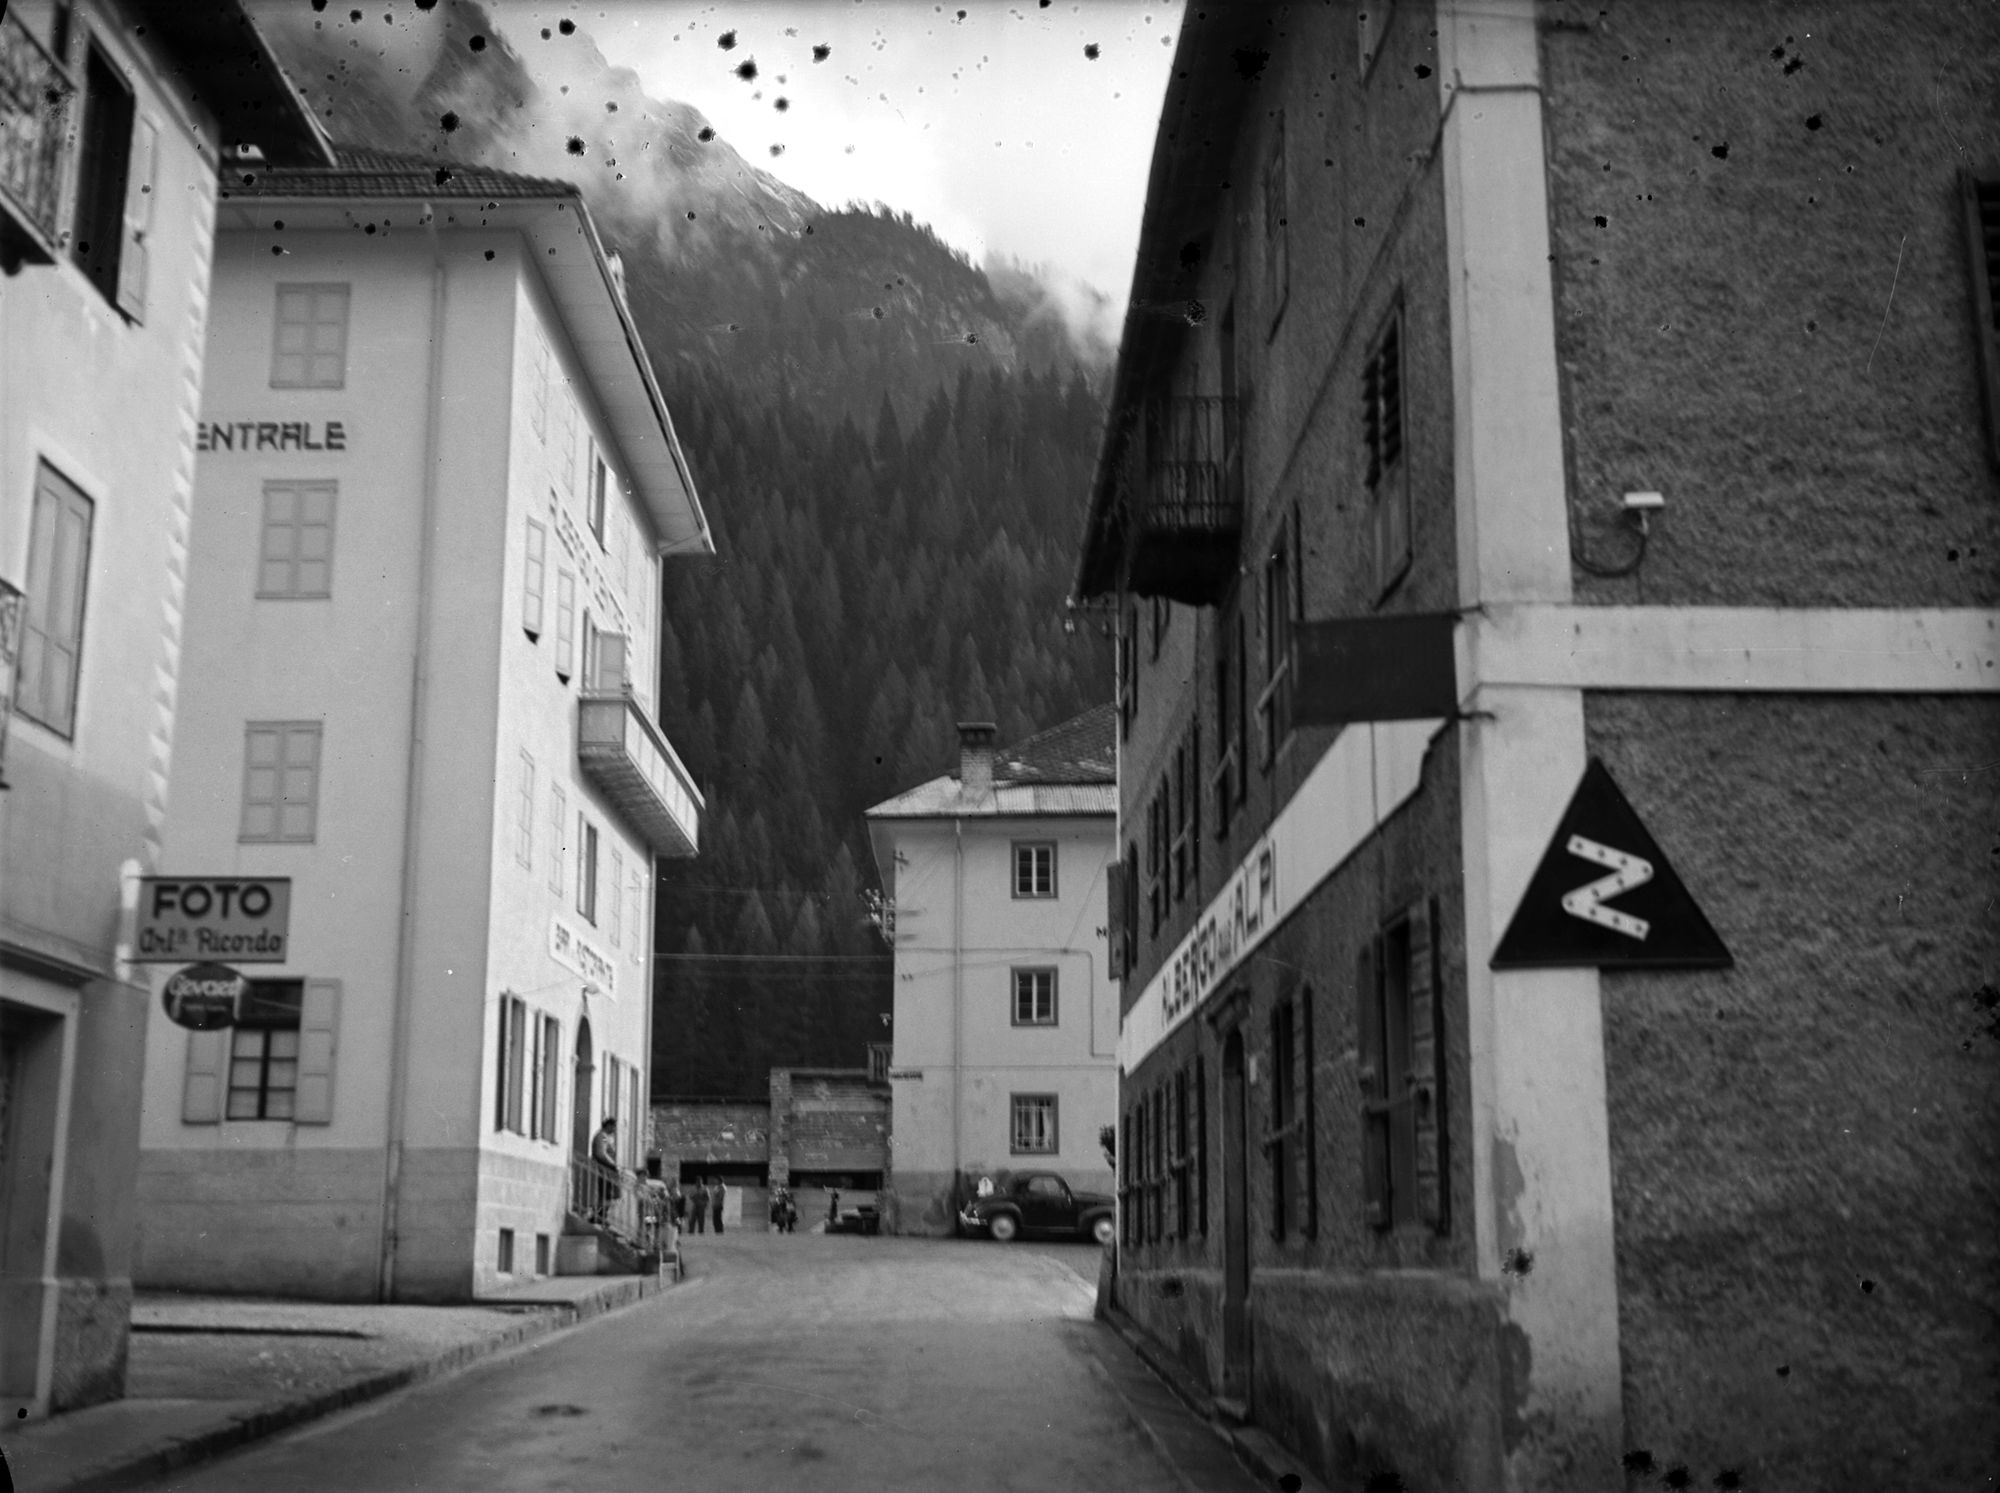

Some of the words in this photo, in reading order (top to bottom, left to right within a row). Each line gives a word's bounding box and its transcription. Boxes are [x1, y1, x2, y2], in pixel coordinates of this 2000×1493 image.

[197, 421, 347, 451] ENTRALE
[152, 884, 272, 919] FOTO
[1162, 915, 1217, 1030] ALBERGO
